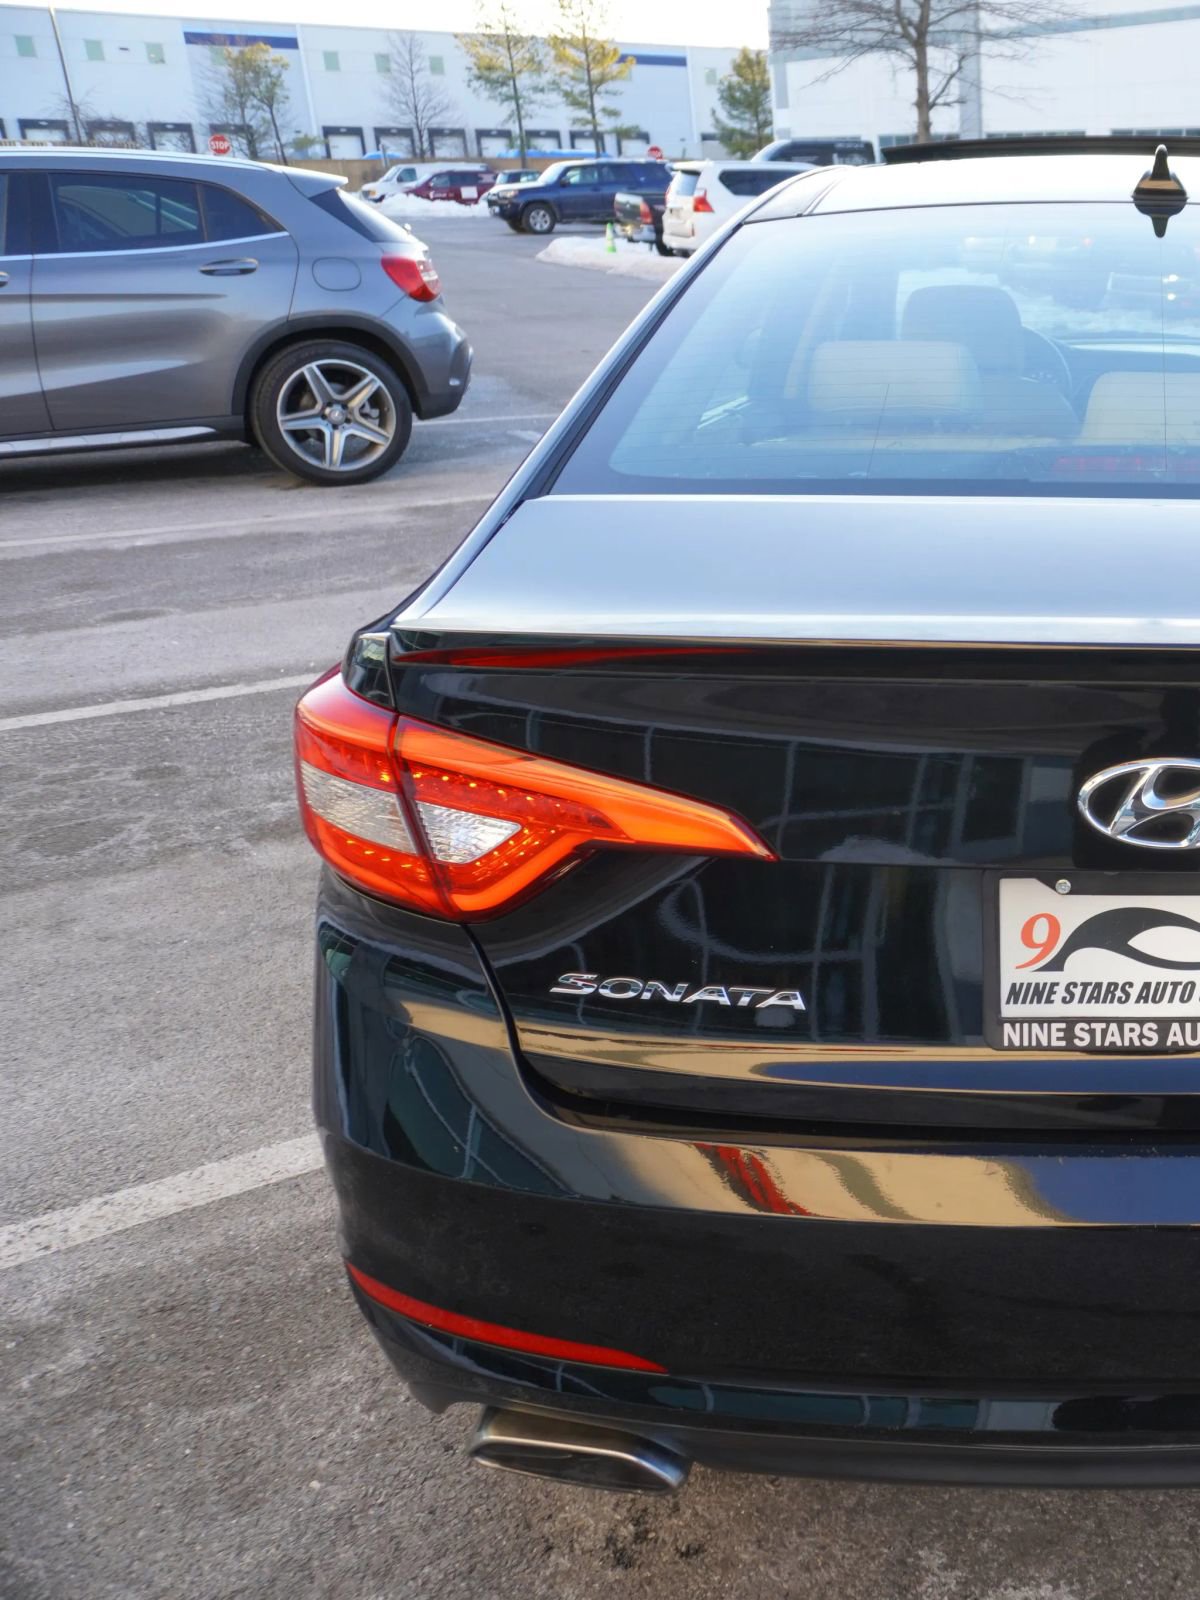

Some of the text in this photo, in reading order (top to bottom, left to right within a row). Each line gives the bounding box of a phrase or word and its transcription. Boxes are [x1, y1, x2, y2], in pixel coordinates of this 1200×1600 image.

[210, 140, 230, 150] STOP
[1015, 912, 1061, 969] 9
[549, 972, 806, 1010] SONATA
[1005, 982, 1060, 1005] NINE
[1061, 981, 1134, 1005] STARS
[1134, 981, 1197, 1004] AUTO
[1003, 1022, 1067, 1047] NINE
[1073, 1022, 1159, 1047] STARS
